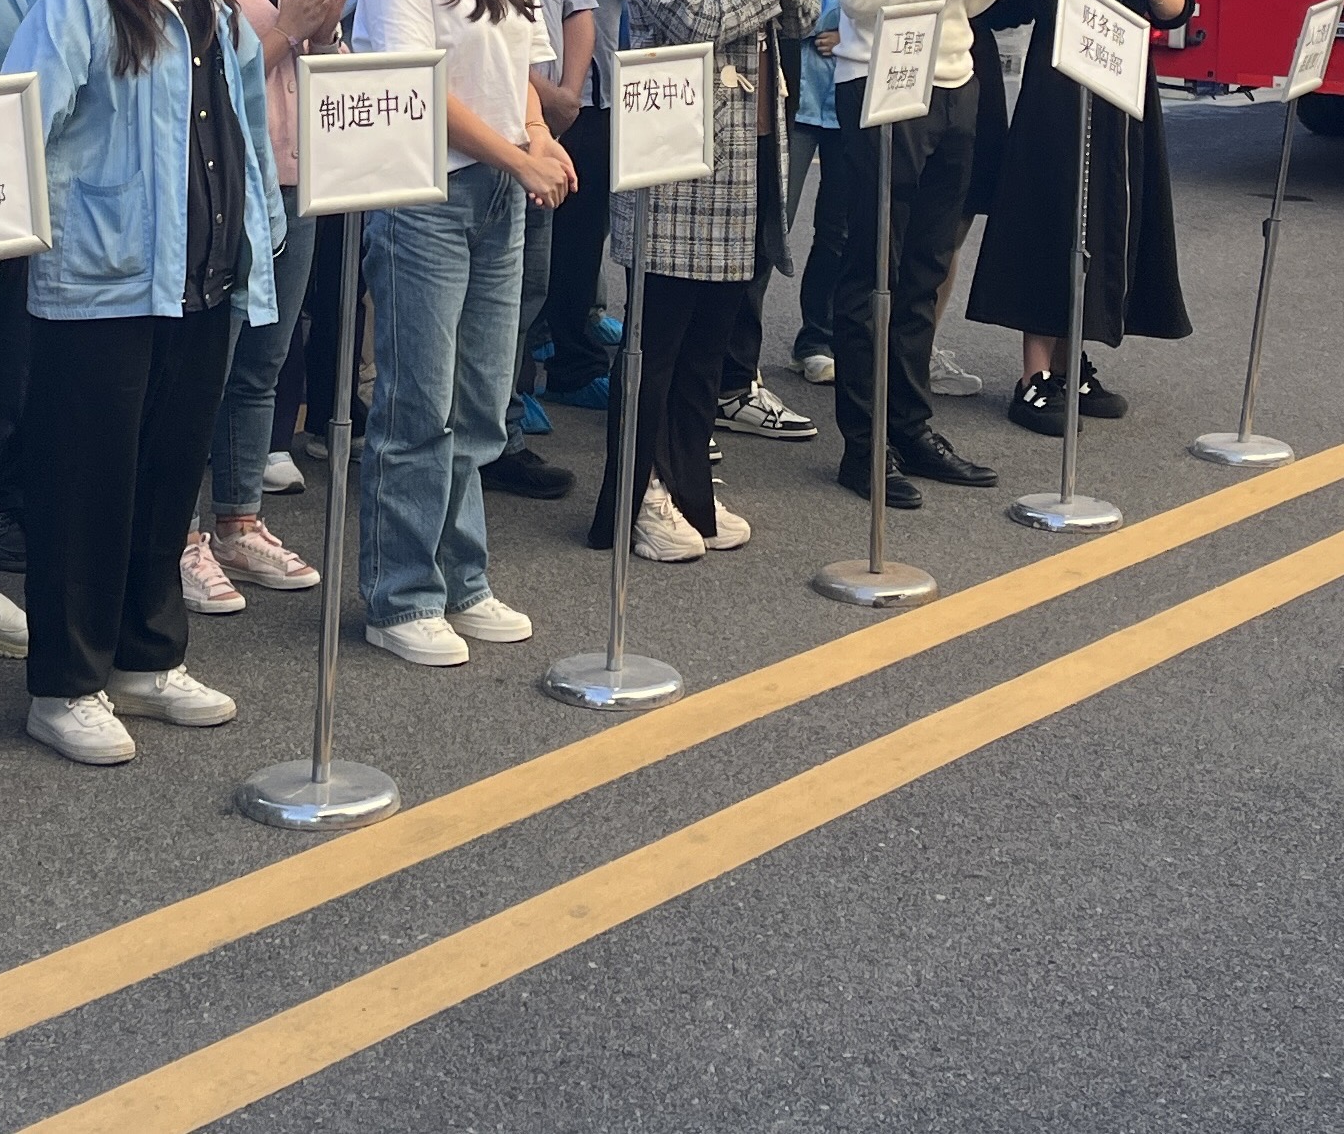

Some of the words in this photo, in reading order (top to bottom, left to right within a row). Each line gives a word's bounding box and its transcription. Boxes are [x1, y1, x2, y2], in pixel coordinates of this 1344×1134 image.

[891, 31, 926, 56] 工程部
[1081, 4, 1126, 47] 财务部
[1078, 35, 1123, 77] 采购部
[318, 88, 427, 133] 制造中心
[622, 76, 696, 114] 研发中心
